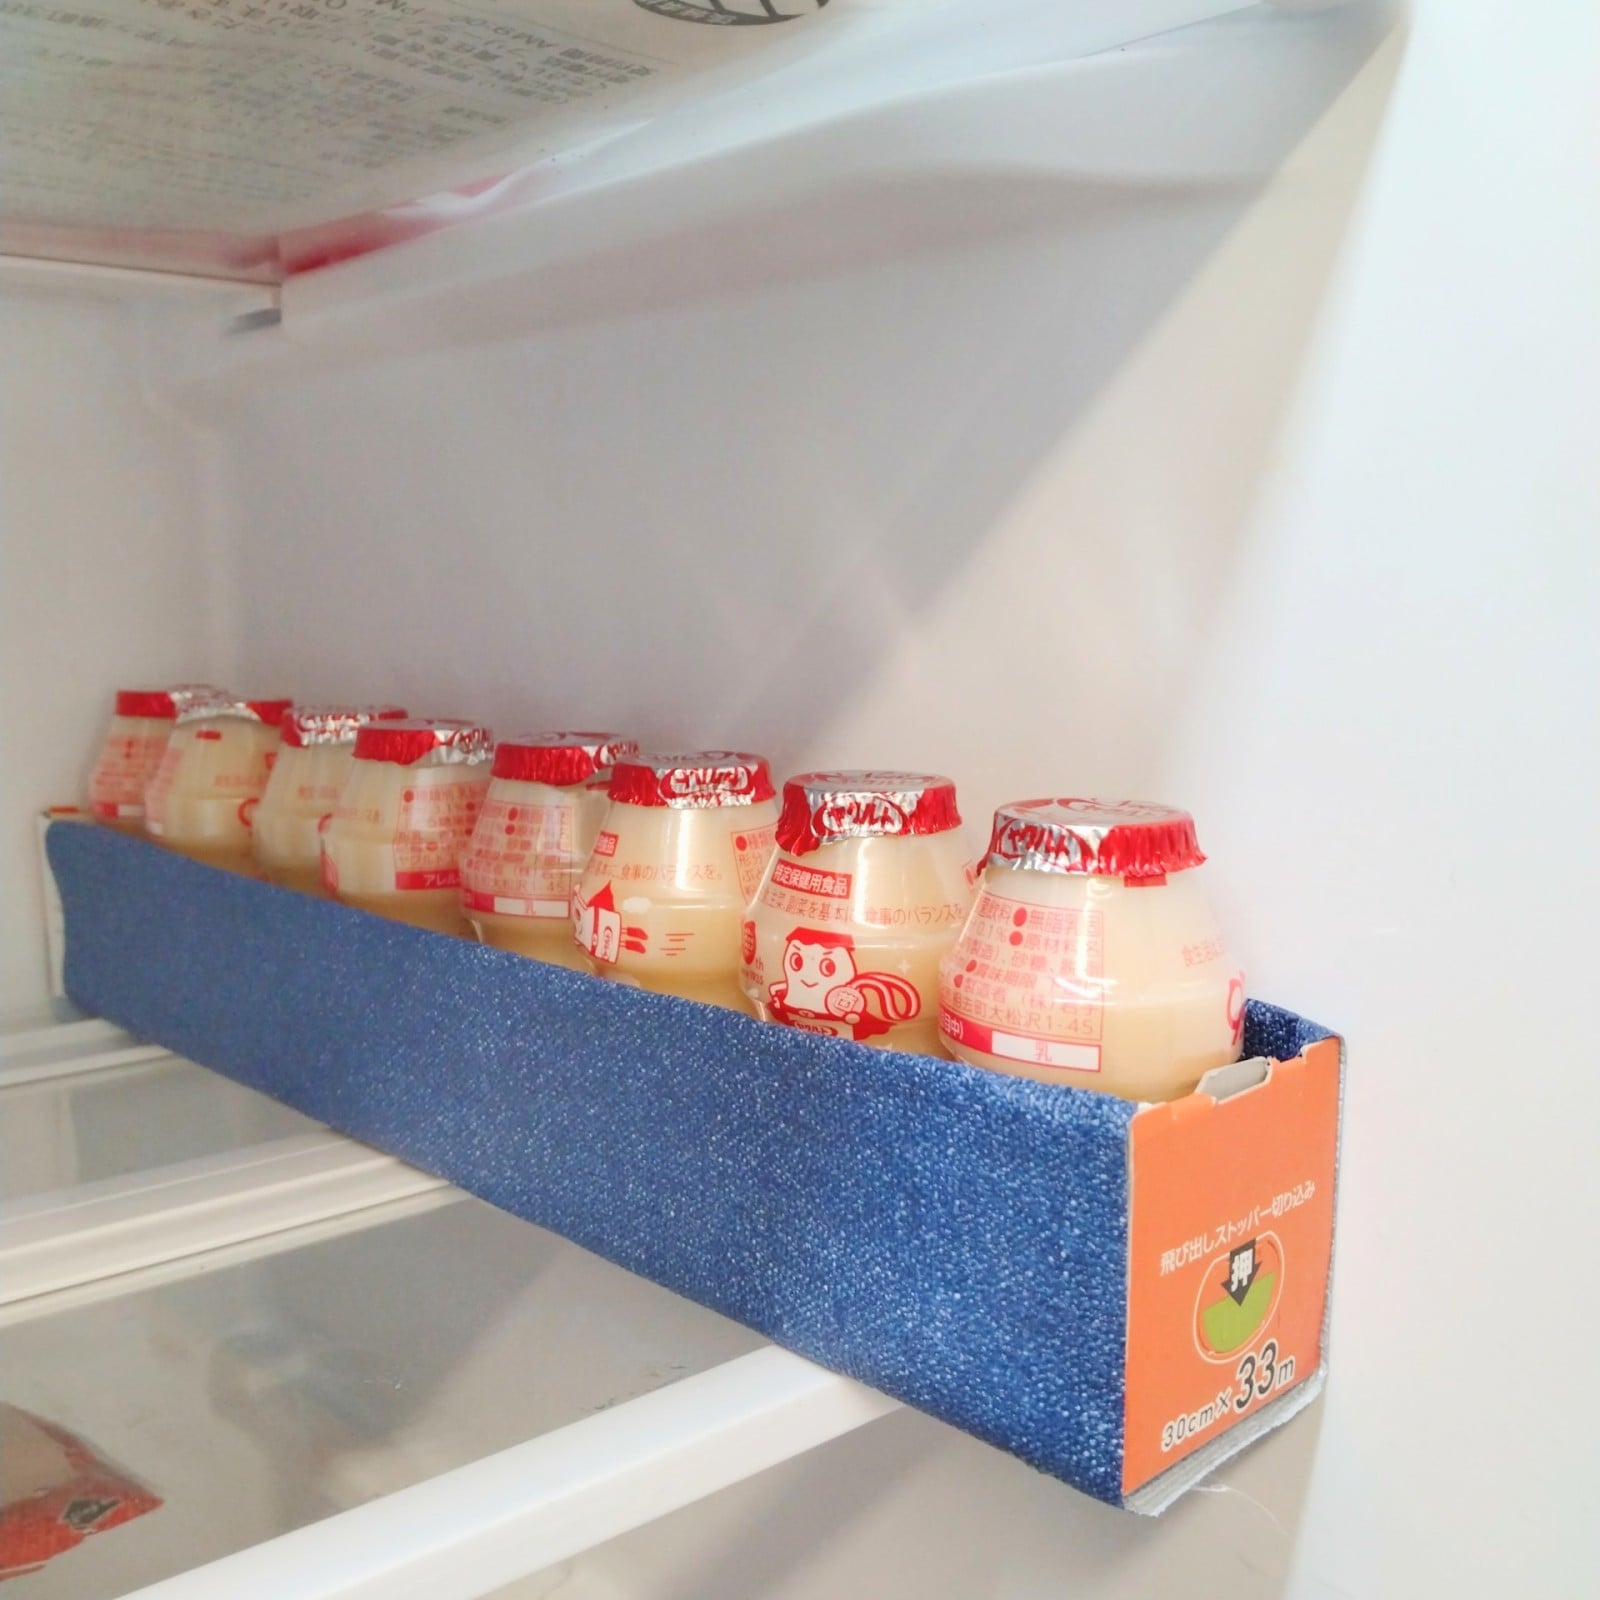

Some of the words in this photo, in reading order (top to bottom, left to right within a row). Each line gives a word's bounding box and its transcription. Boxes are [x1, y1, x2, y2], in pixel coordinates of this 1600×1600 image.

[1160, 1180, 1316, 1277] 飛び出しストッパー切り込み
[1230, 1248, 1254, 1293] 押
